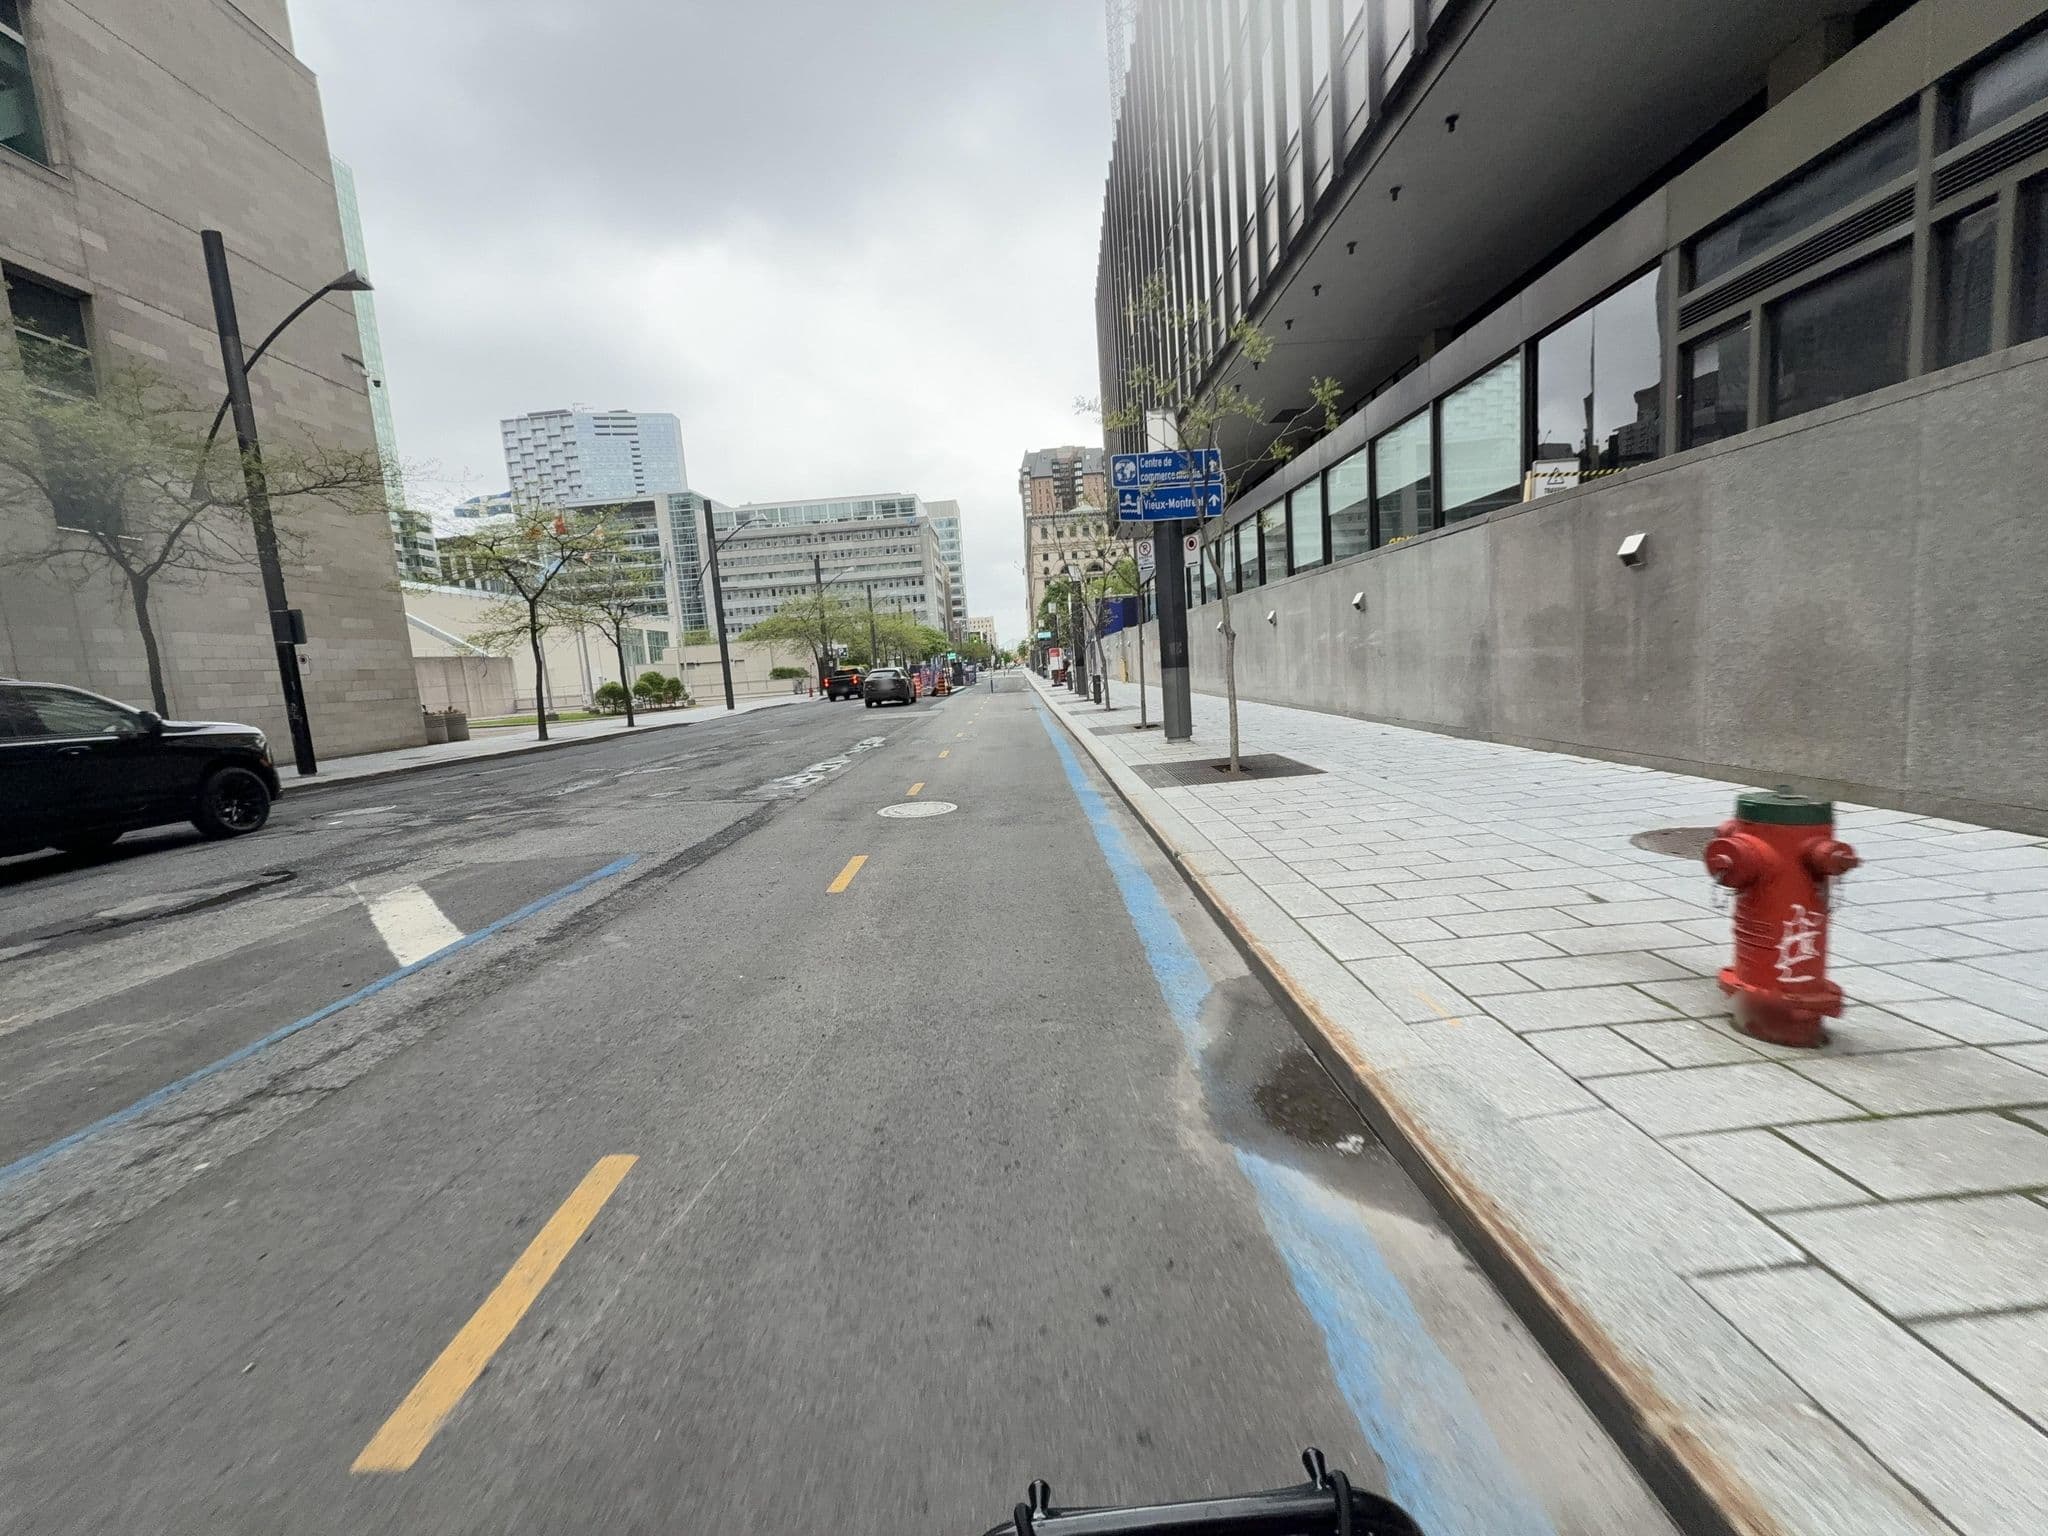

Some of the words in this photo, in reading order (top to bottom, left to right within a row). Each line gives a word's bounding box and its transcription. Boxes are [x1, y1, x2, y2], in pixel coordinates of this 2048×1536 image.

[1140, 457, 1162, 468] Centre
[1164, 456, 1172, 466] de
[1140, 472, 1176, 482] commerce
